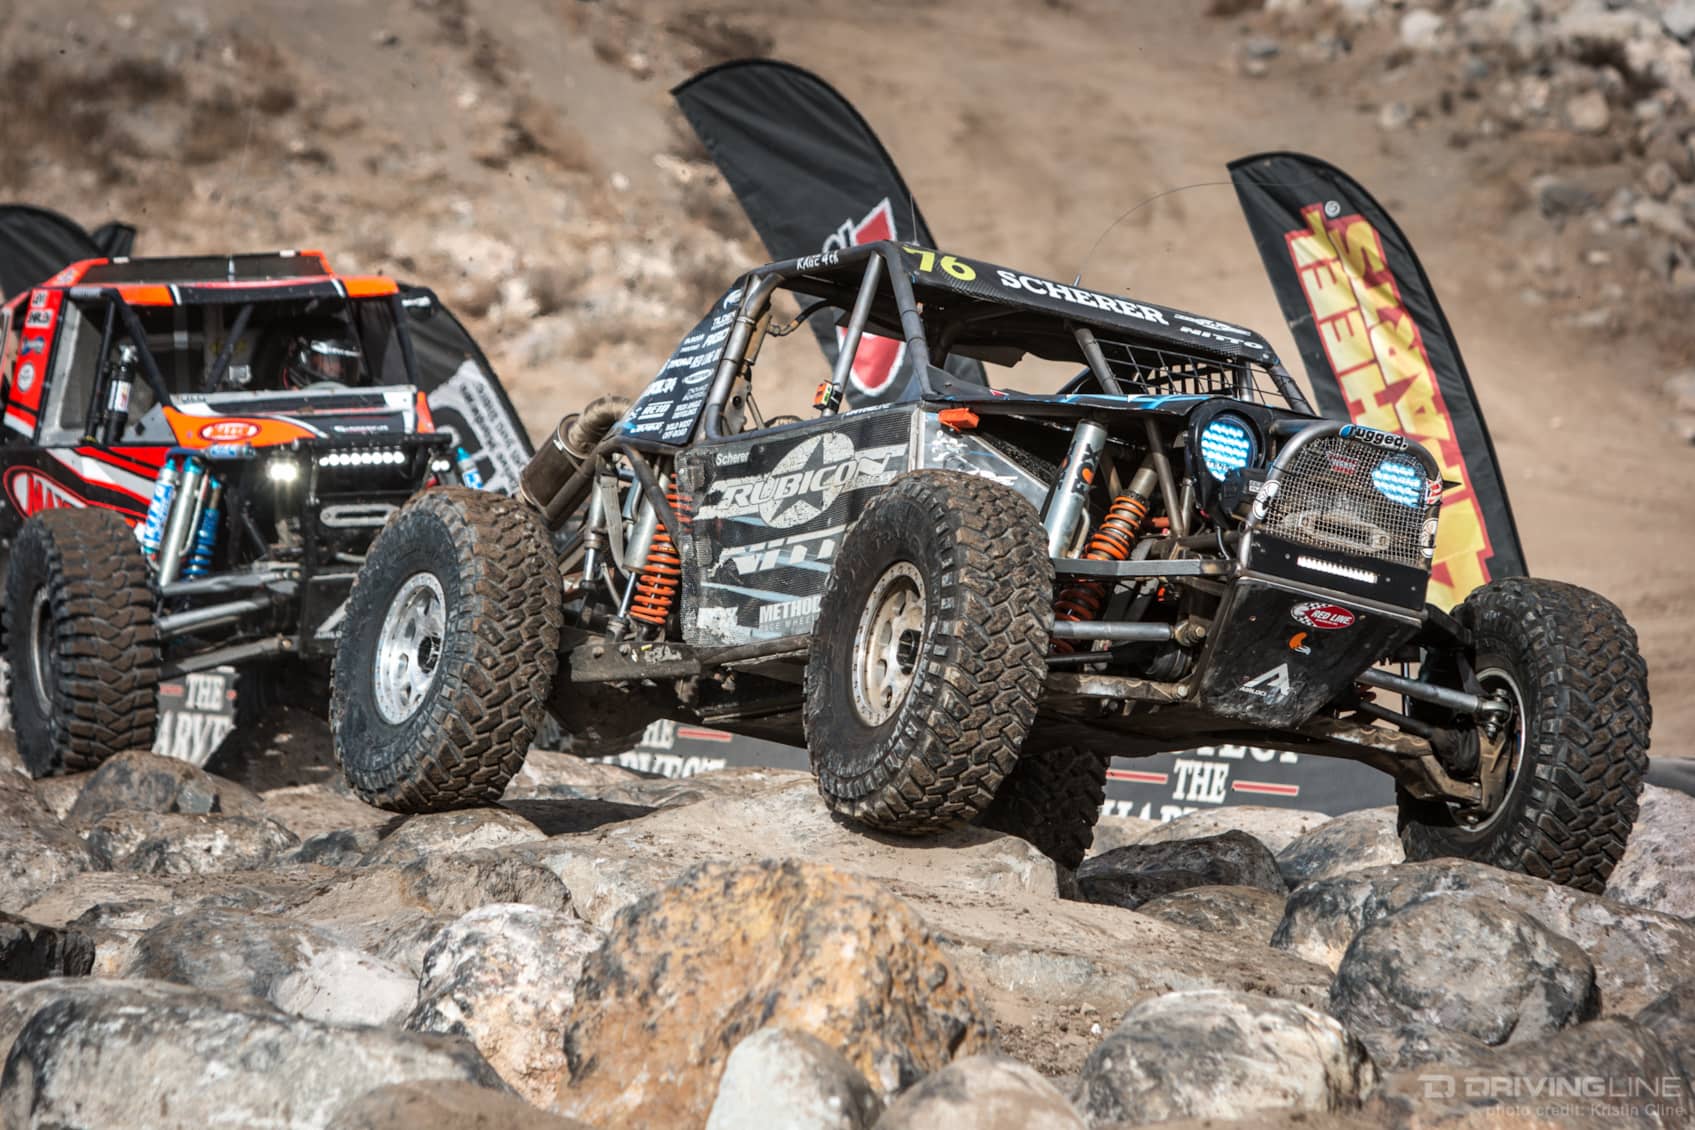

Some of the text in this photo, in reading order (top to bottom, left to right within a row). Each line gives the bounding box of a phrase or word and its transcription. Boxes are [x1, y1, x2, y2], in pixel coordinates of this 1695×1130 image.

[902, 245, 977, 281] 76
[997, 269, 1169, 325] SCHERER
[1180, 326, 1264, 350] NITTO
[1286, 207, 1408, 433] HEEL
[715, 453, 892, 510] RUBICON
[1311, 609, 1331, 621] RED
[1330, 614, 1352, 625] LINE
[186, 673, 225, 711] THE
[1172, 758, 1229, 804] THE
